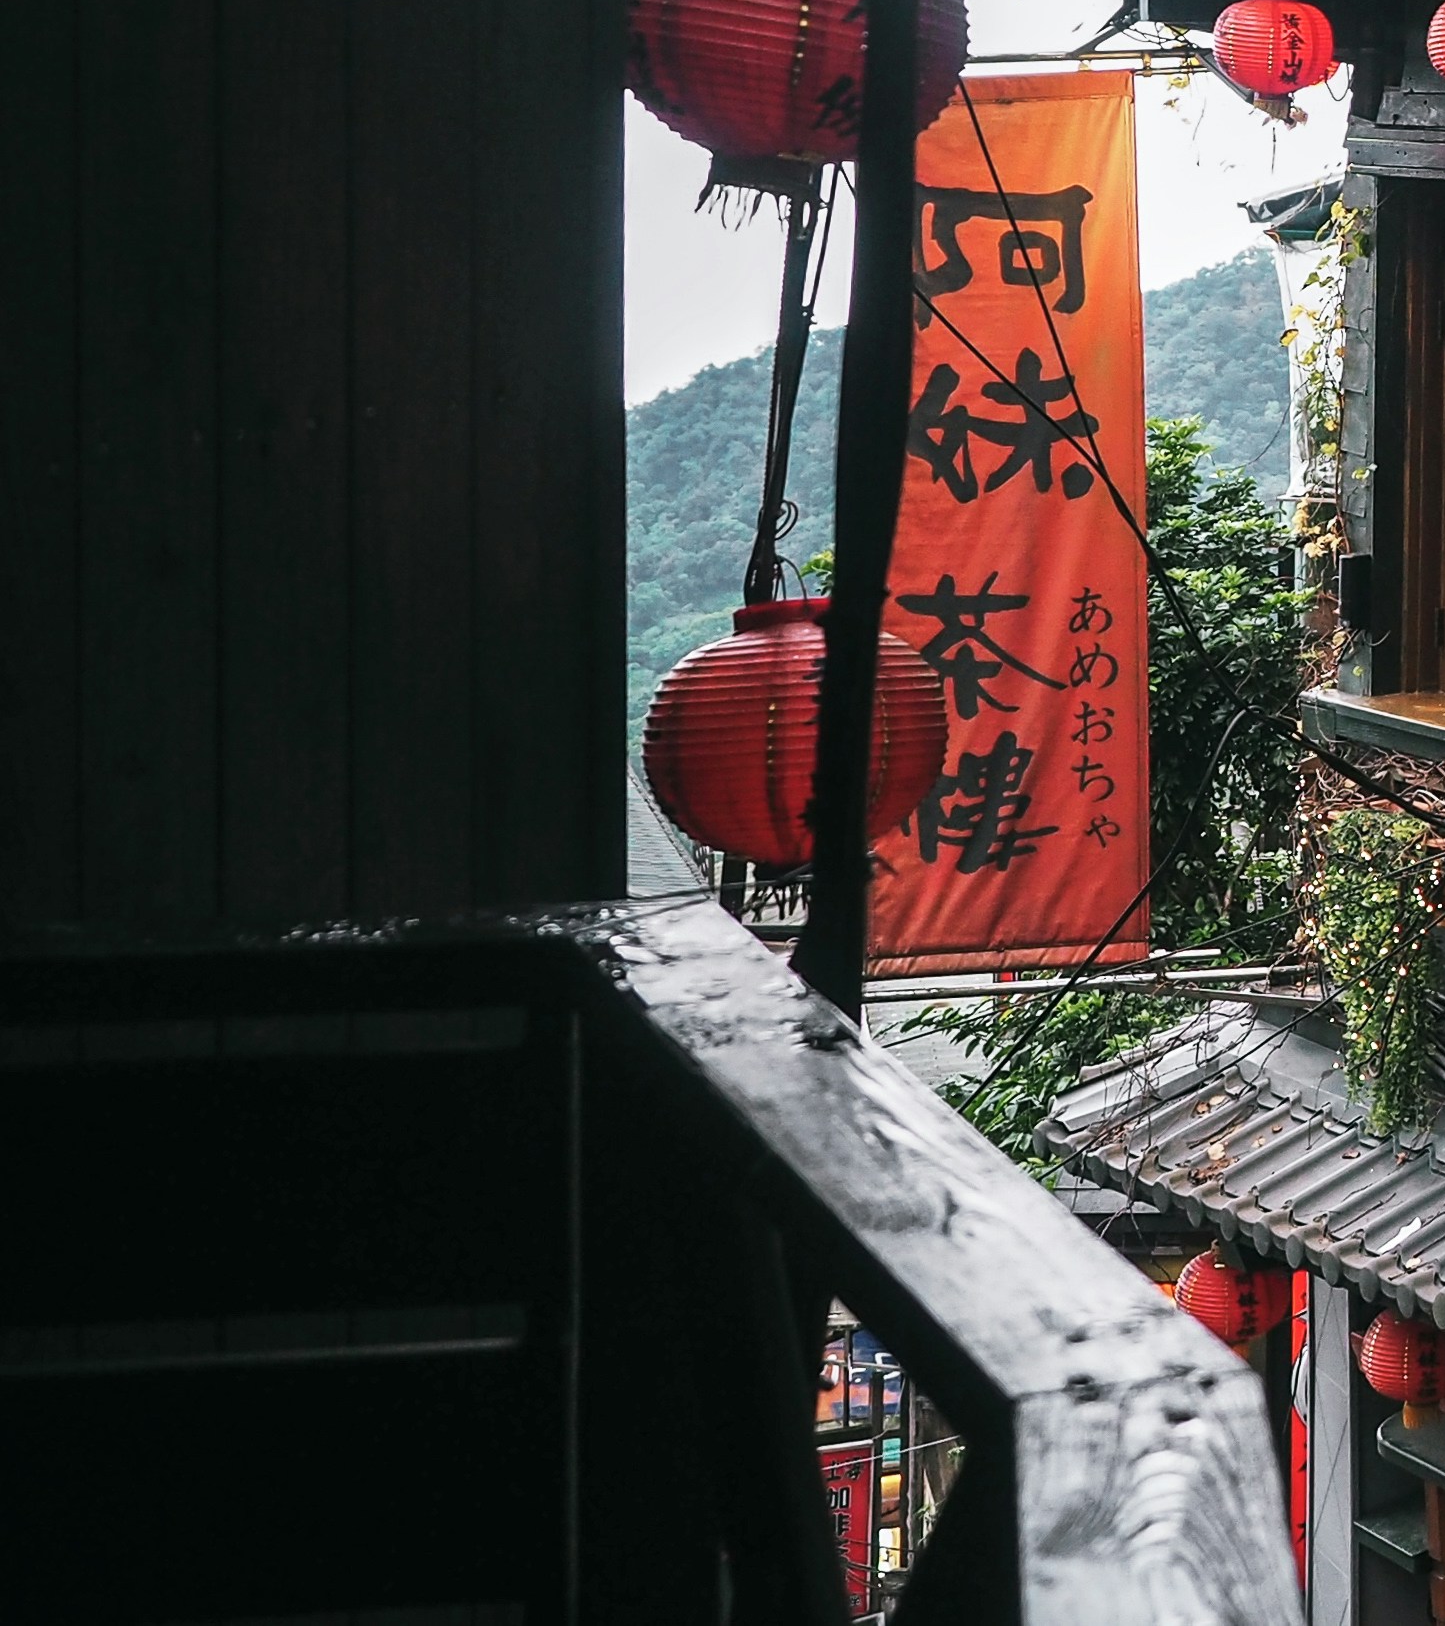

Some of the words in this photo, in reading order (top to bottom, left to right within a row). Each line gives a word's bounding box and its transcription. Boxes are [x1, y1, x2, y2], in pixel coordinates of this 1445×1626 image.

[1067, 585, 1121, 849] あめおちゃ
